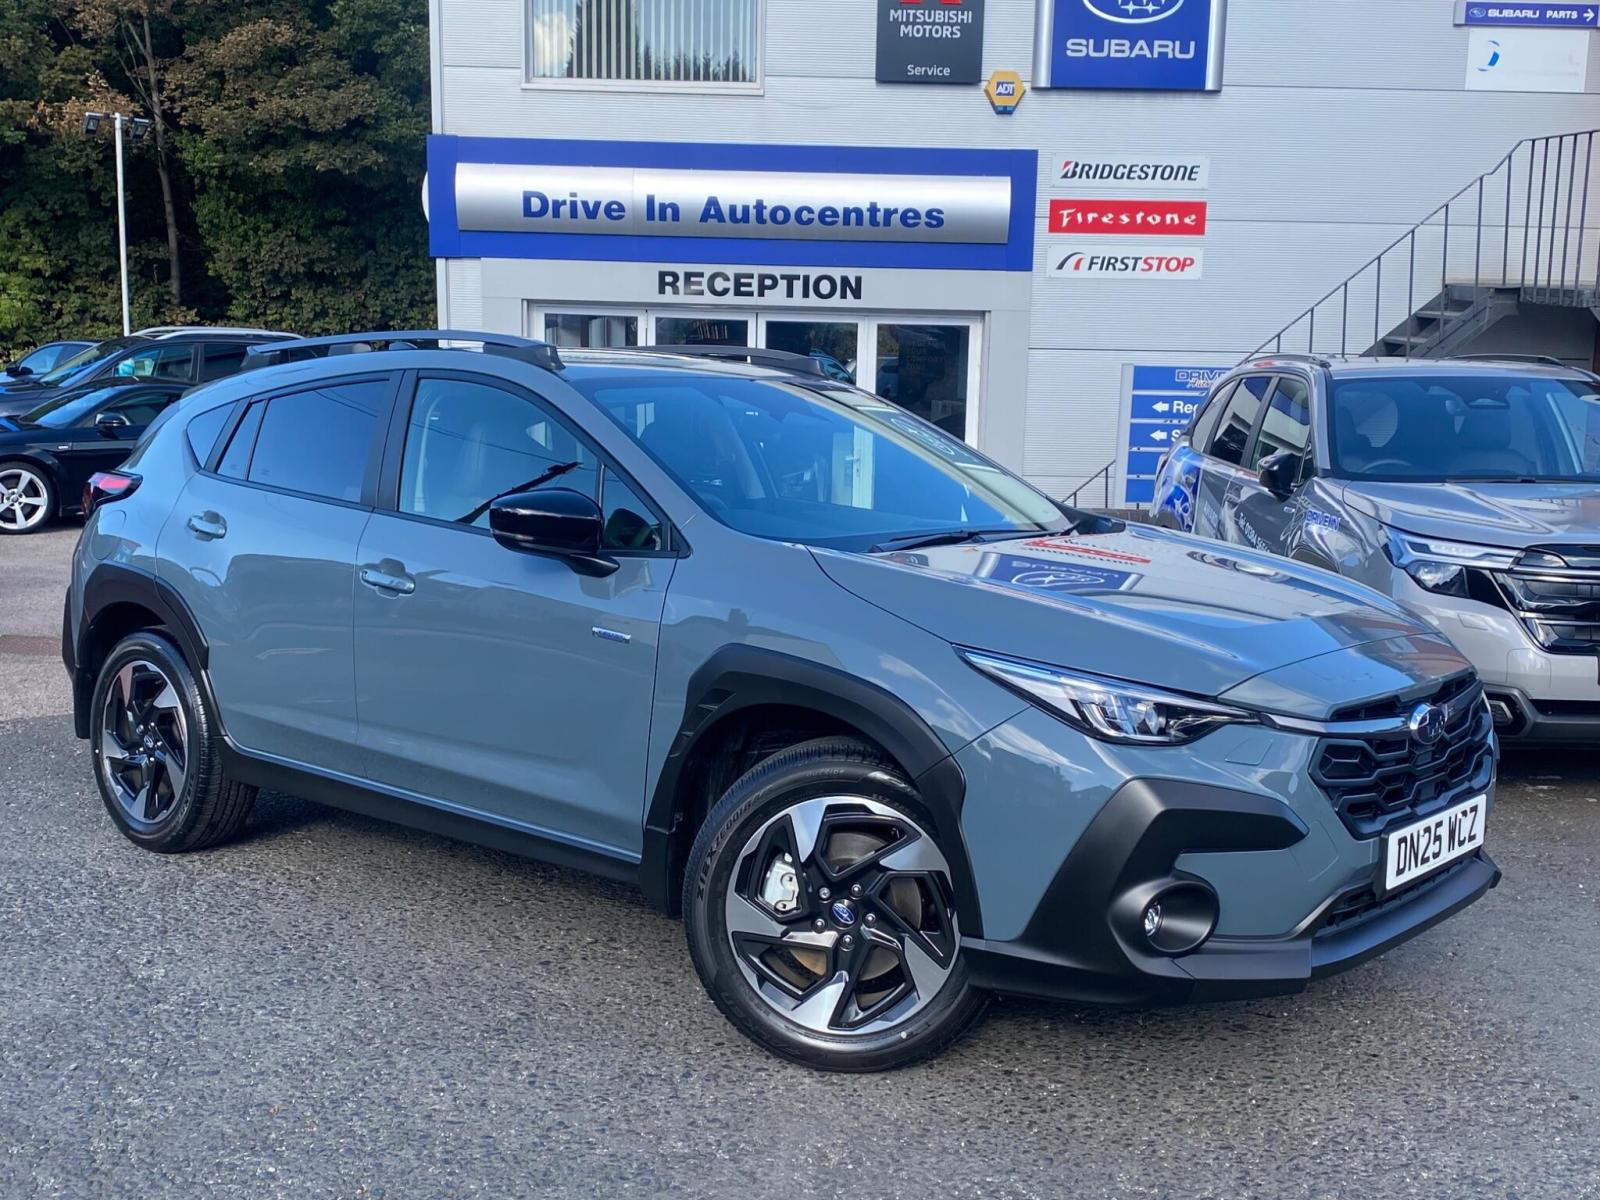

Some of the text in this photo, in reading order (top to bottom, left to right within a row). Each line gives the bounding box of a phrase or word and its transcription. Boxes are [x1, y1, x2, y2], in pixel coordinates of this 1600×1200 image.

[889, 9, 972, 23] MITSUBISHI
[1488, 9, 1578, 19] SUBARU PARTS
[900, 24, 961, 38] MOTORS
[1065, 38, 1196, 60] SUBARU
[907, 64, 951, 76] Service
[996, 82, 1014, 95] ADT
[1060, 160, 1201, 182] BRIDGESTONE
[521, 190, 945, 229] Drive In Autocentres
[1059, 208, 1197, 228] Firestone
[1087, 255, 1195, 273] FIRSTSTOP
[657, 270, 863, 300] RECEPTION
[1395, 804, 1479, 877] DN25 WCZ
